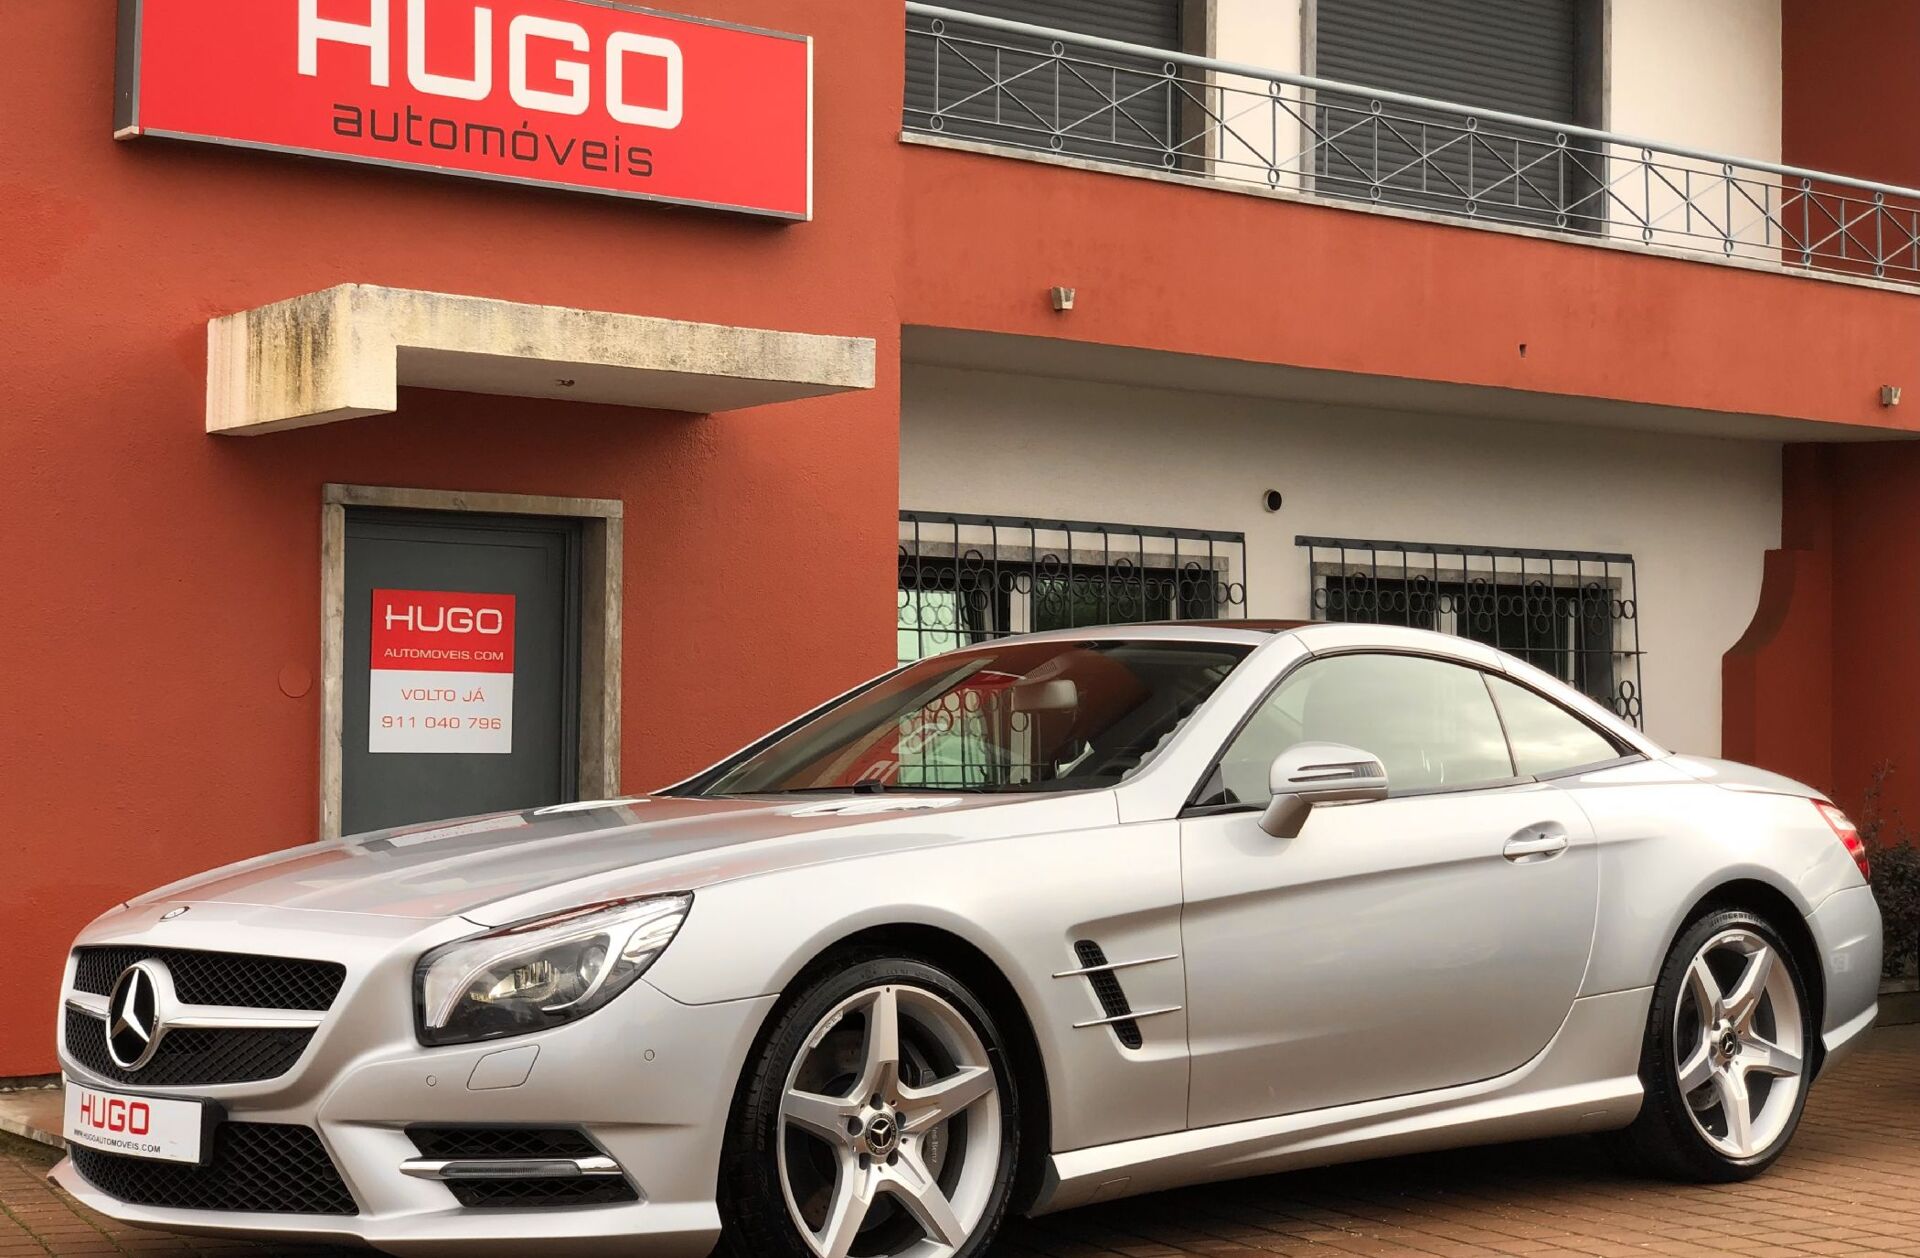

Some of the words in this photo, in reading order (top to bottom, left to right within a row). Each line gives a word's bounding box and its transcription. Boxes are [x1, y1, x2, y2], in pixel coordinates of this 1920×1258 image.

[298, 0, 683, 130] HUGO
[333, 103, 653, 178] automóveis
[385, 604, 503, 635] HUGO
[384, 648, 504, 661] AUTOMOVEIS.COM
[401, 688, 456, 702] VOLTO
[462, 687, 485, 703] JÁ
[381, 715, 416, 729] 911
[424, 716, 461, 730] 040
[468, 717, 502, 731] 796
[80, 1091, 150, 1136] HUGO
